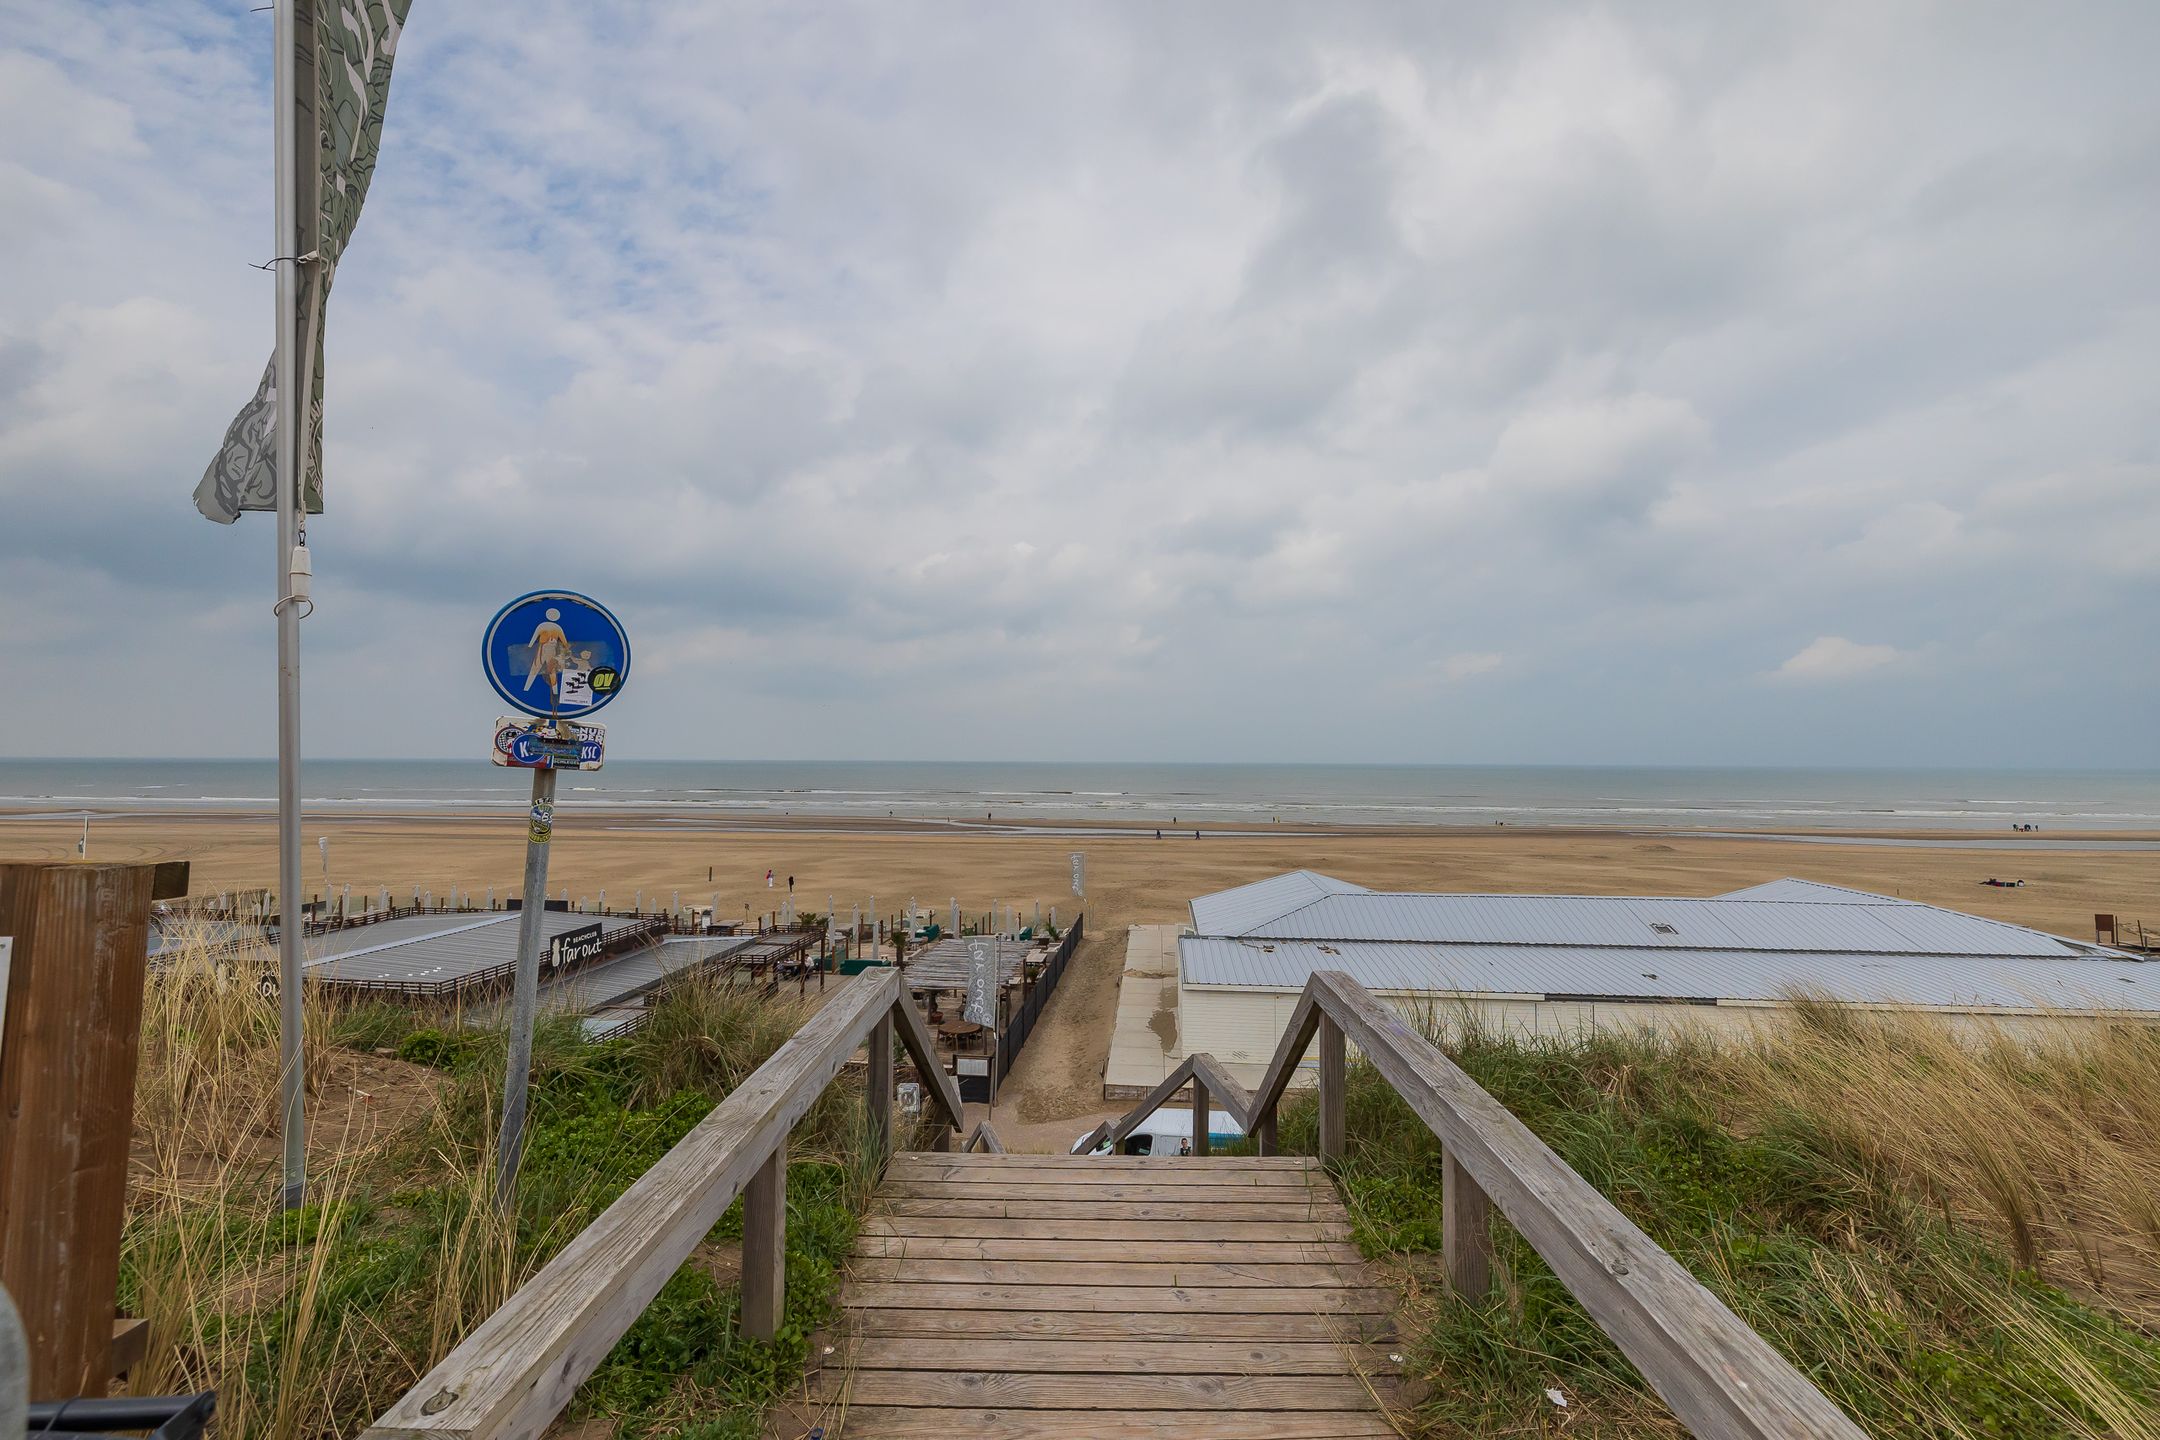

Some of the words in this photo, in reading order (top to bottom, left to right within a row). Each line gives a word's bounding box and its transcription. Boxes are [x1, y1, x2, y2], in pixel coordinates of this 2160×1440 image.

[580, 727, 604, 737] NUR
[581, 746, 598, 759] KSC
[561, 937, 582, 964] far
[582, 938, 602, 957] out
